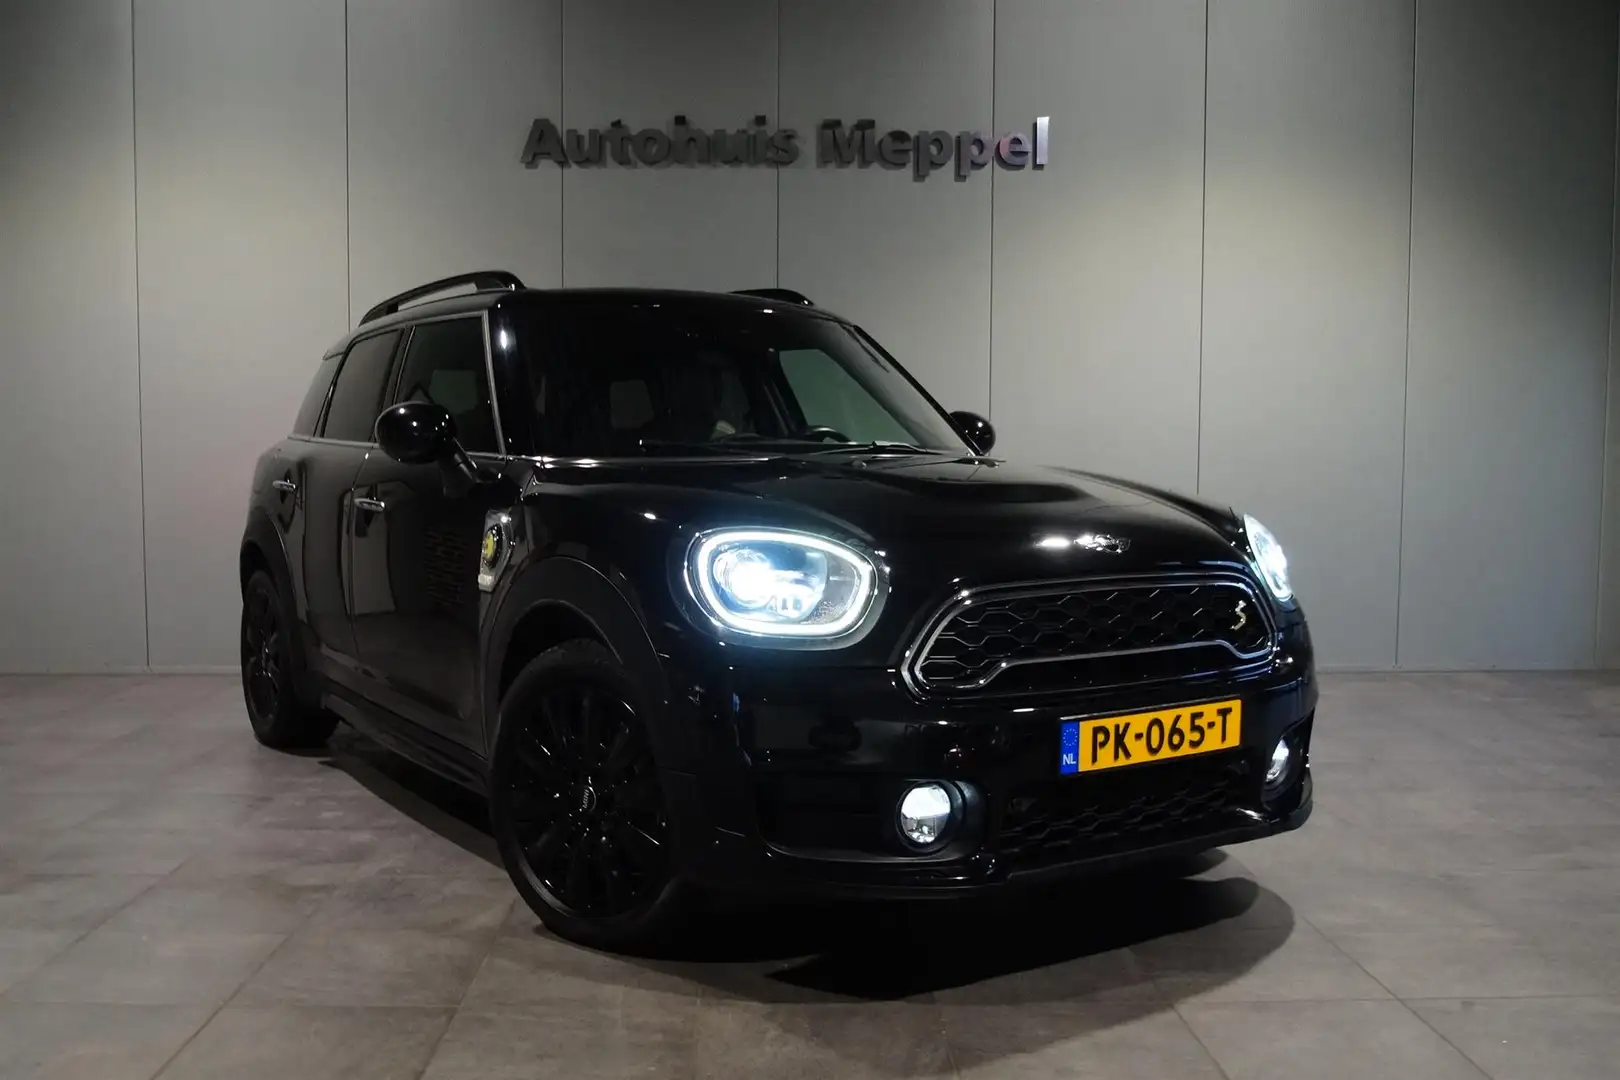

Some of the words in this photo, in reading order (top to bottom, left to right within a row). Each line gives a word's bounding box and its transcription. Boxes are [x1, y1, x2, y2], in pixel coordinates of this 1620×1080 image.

[520, 115, 802, 169] Autohuis
[816, 116, 1051, 182] Meppel
[1062, 752, 1077, 766] NL
[1091, 707, 1233, 766] PK-065-T
